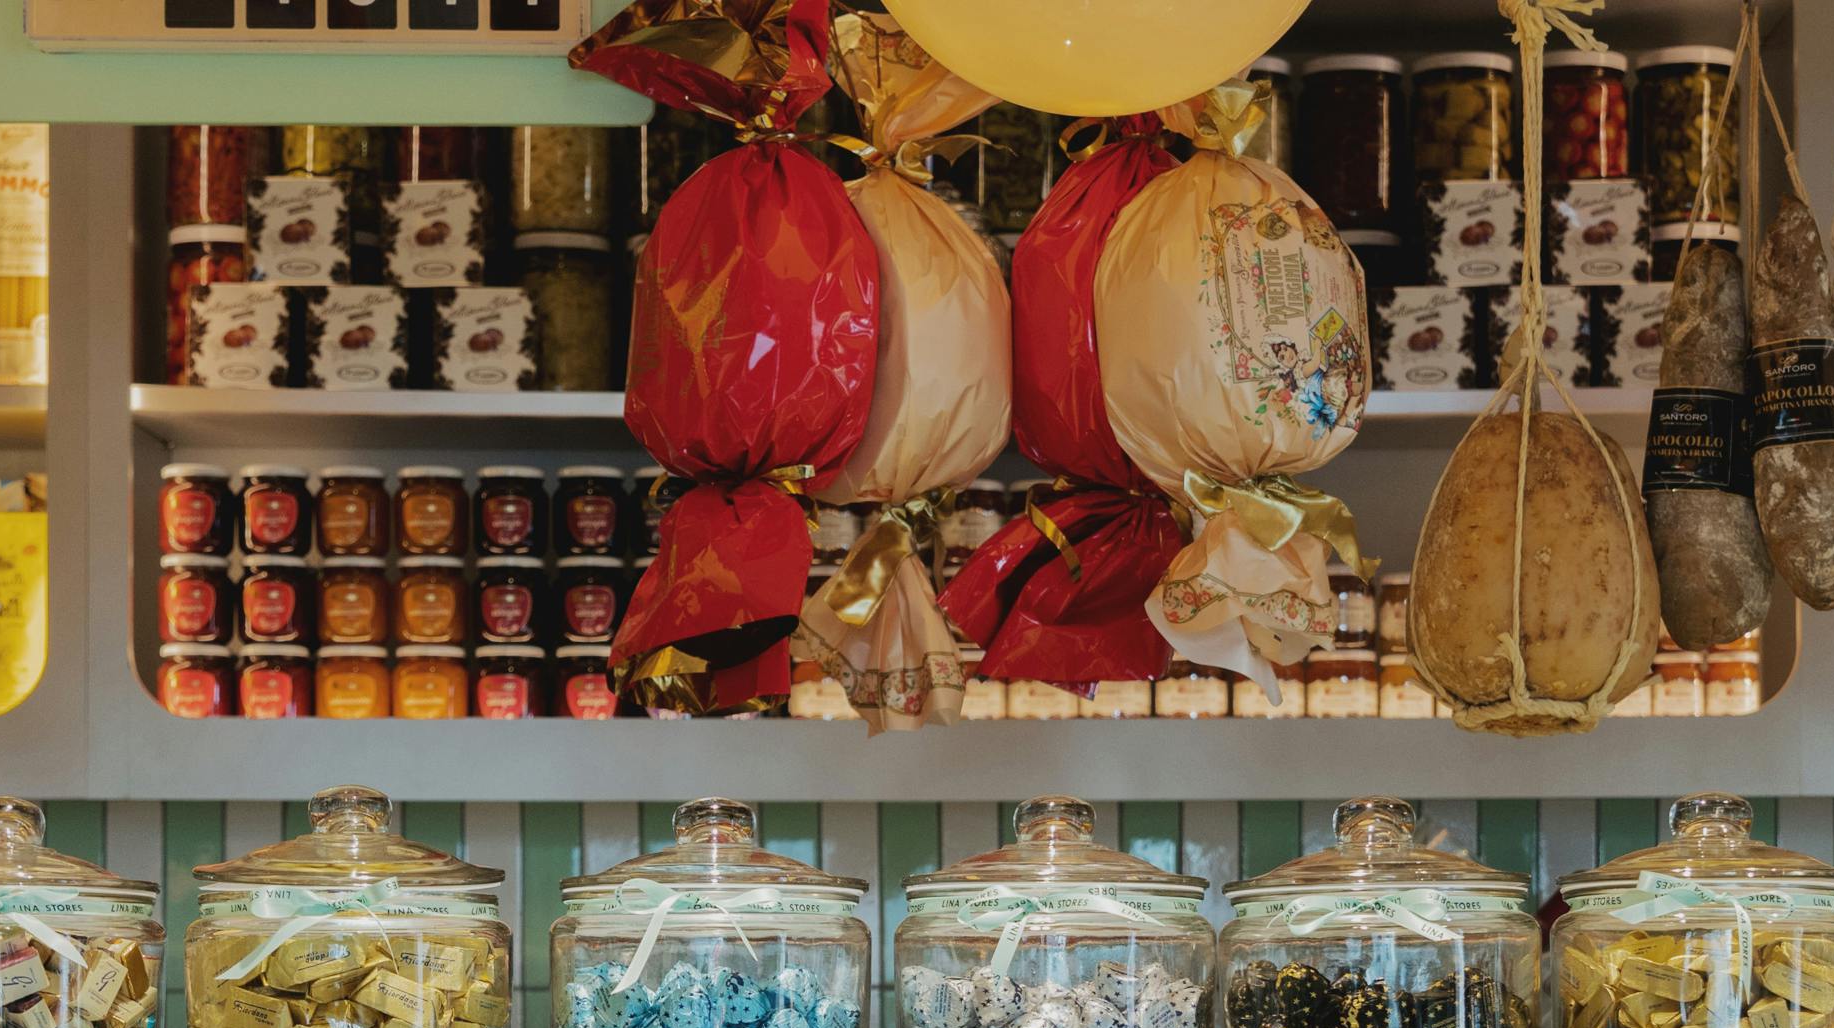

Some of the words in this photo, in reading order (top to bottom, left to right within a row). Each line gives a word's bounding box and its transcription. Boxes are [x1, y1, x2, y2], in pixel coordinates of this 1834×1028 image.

[1764, 363, 1816, 377] SANTORO
[1659, 413, 1708, 422] SANTORO
[13, 903, 39, 913] LINA
[42, 903, 83, 914] STORES
[1420, 922, 1445, 940] LINA
